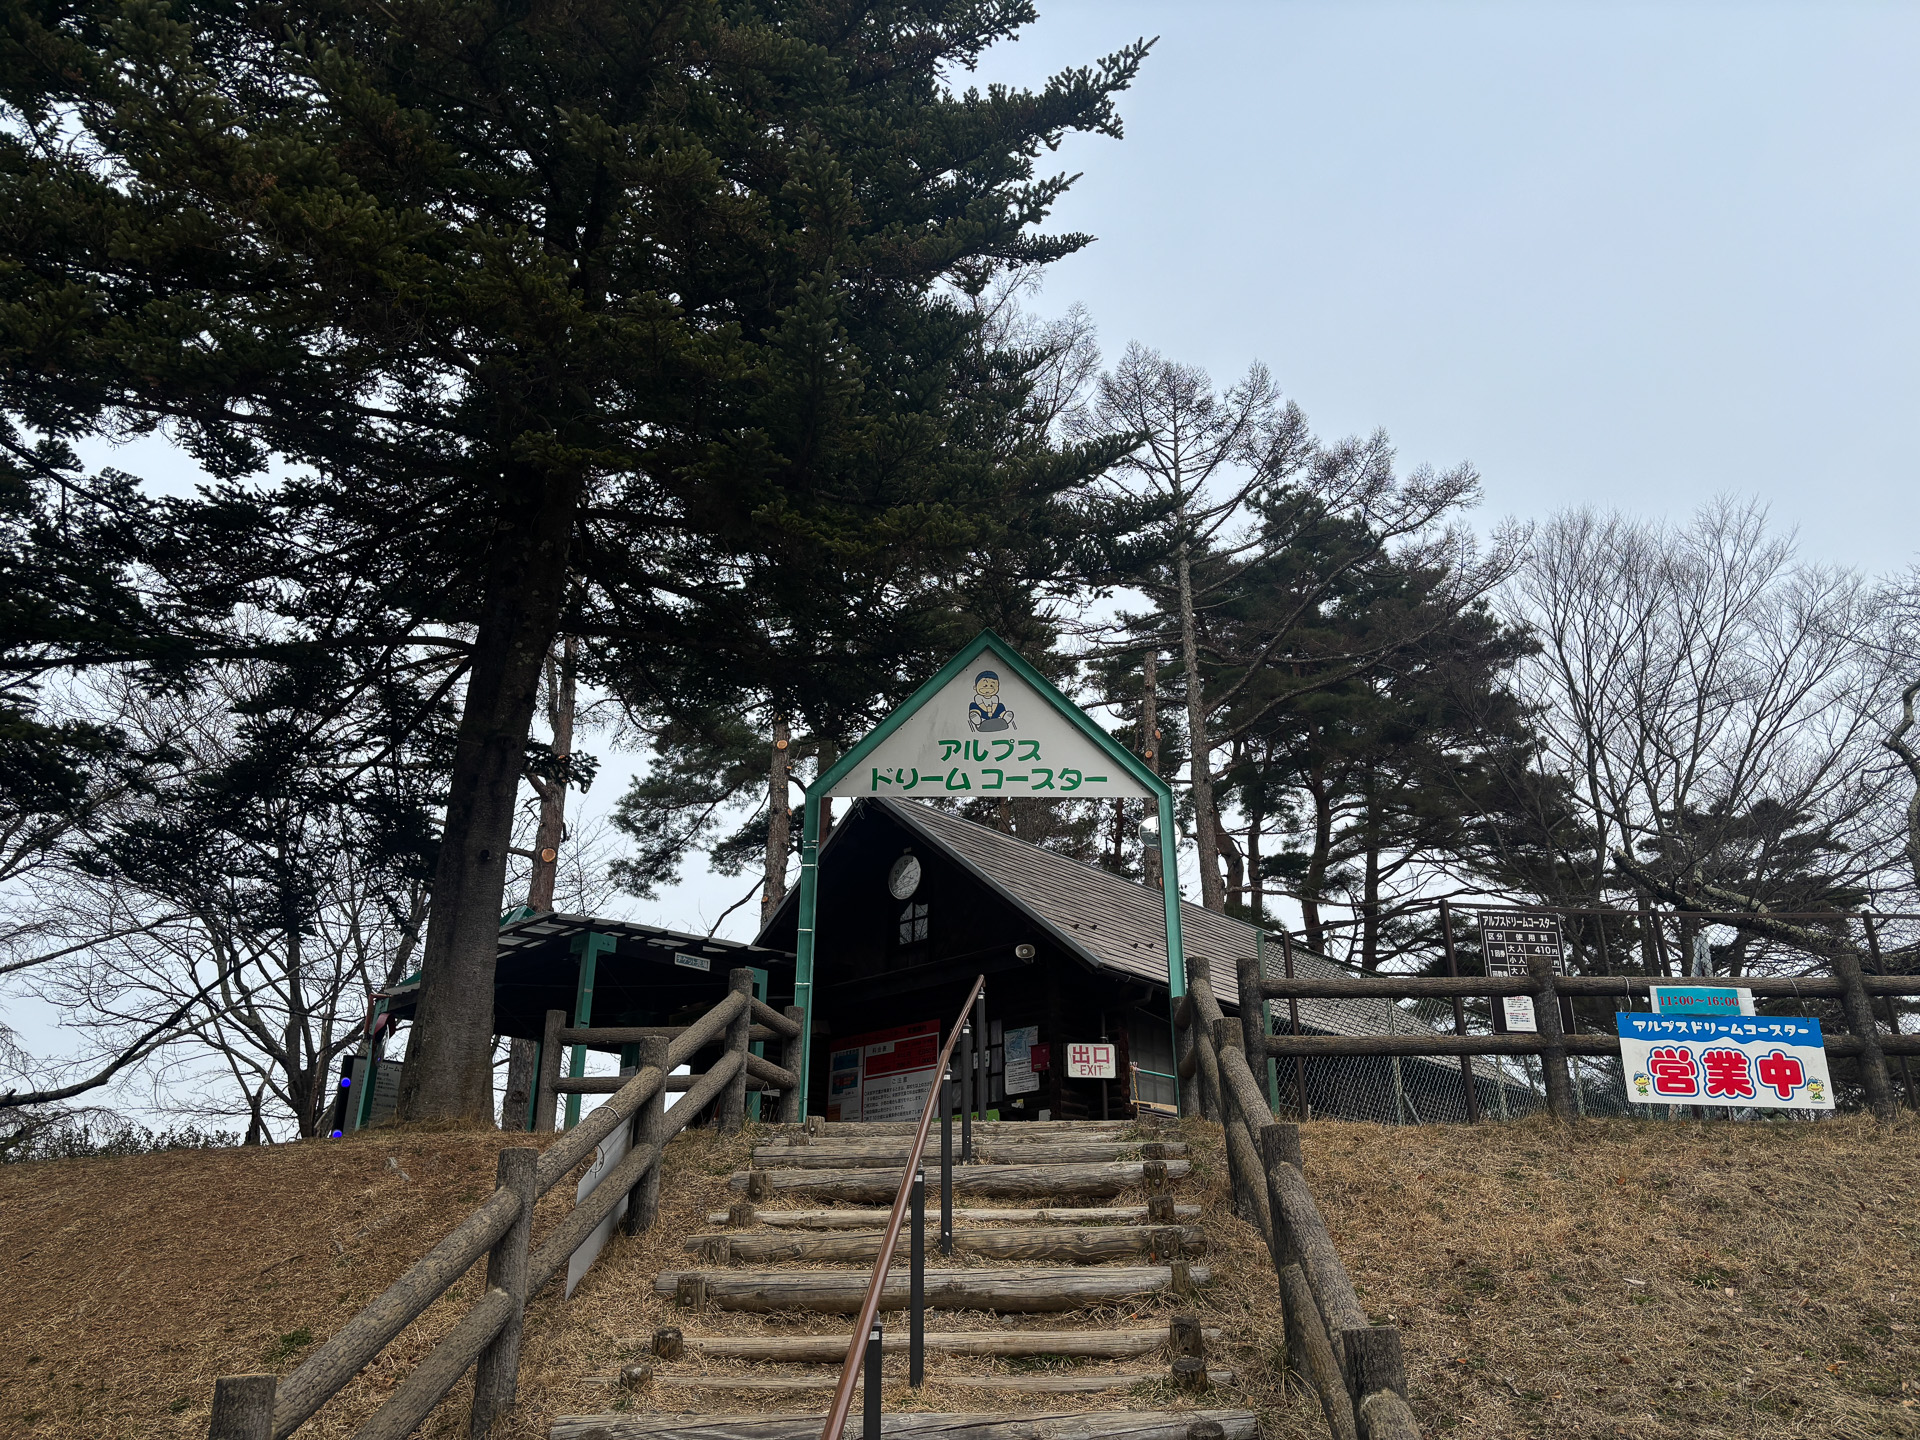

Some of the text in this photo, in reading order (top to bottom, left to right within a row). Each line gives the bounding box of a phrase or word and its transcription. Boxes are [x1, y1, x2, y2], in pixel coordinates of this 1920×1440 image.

[938, 739, 1042, 762] アルプス
[1482, 916, 1556, 928] アルプスドリームコースター
[1487, 933, 1503, 941] 区分
[1508, 945, 1523, 953] 大人
[1510, 956, 1525, 964] 小人
[1511, 967, 1526, 975] 大人
[1632, 1019, 1809, 1037] アルプスドリームコースター
[1072, 1045, 1110, 1065] 出口
[1080, 1064, 1104, 1076] EXIT
[1648, 1046, 1804, 1100] 営業中
